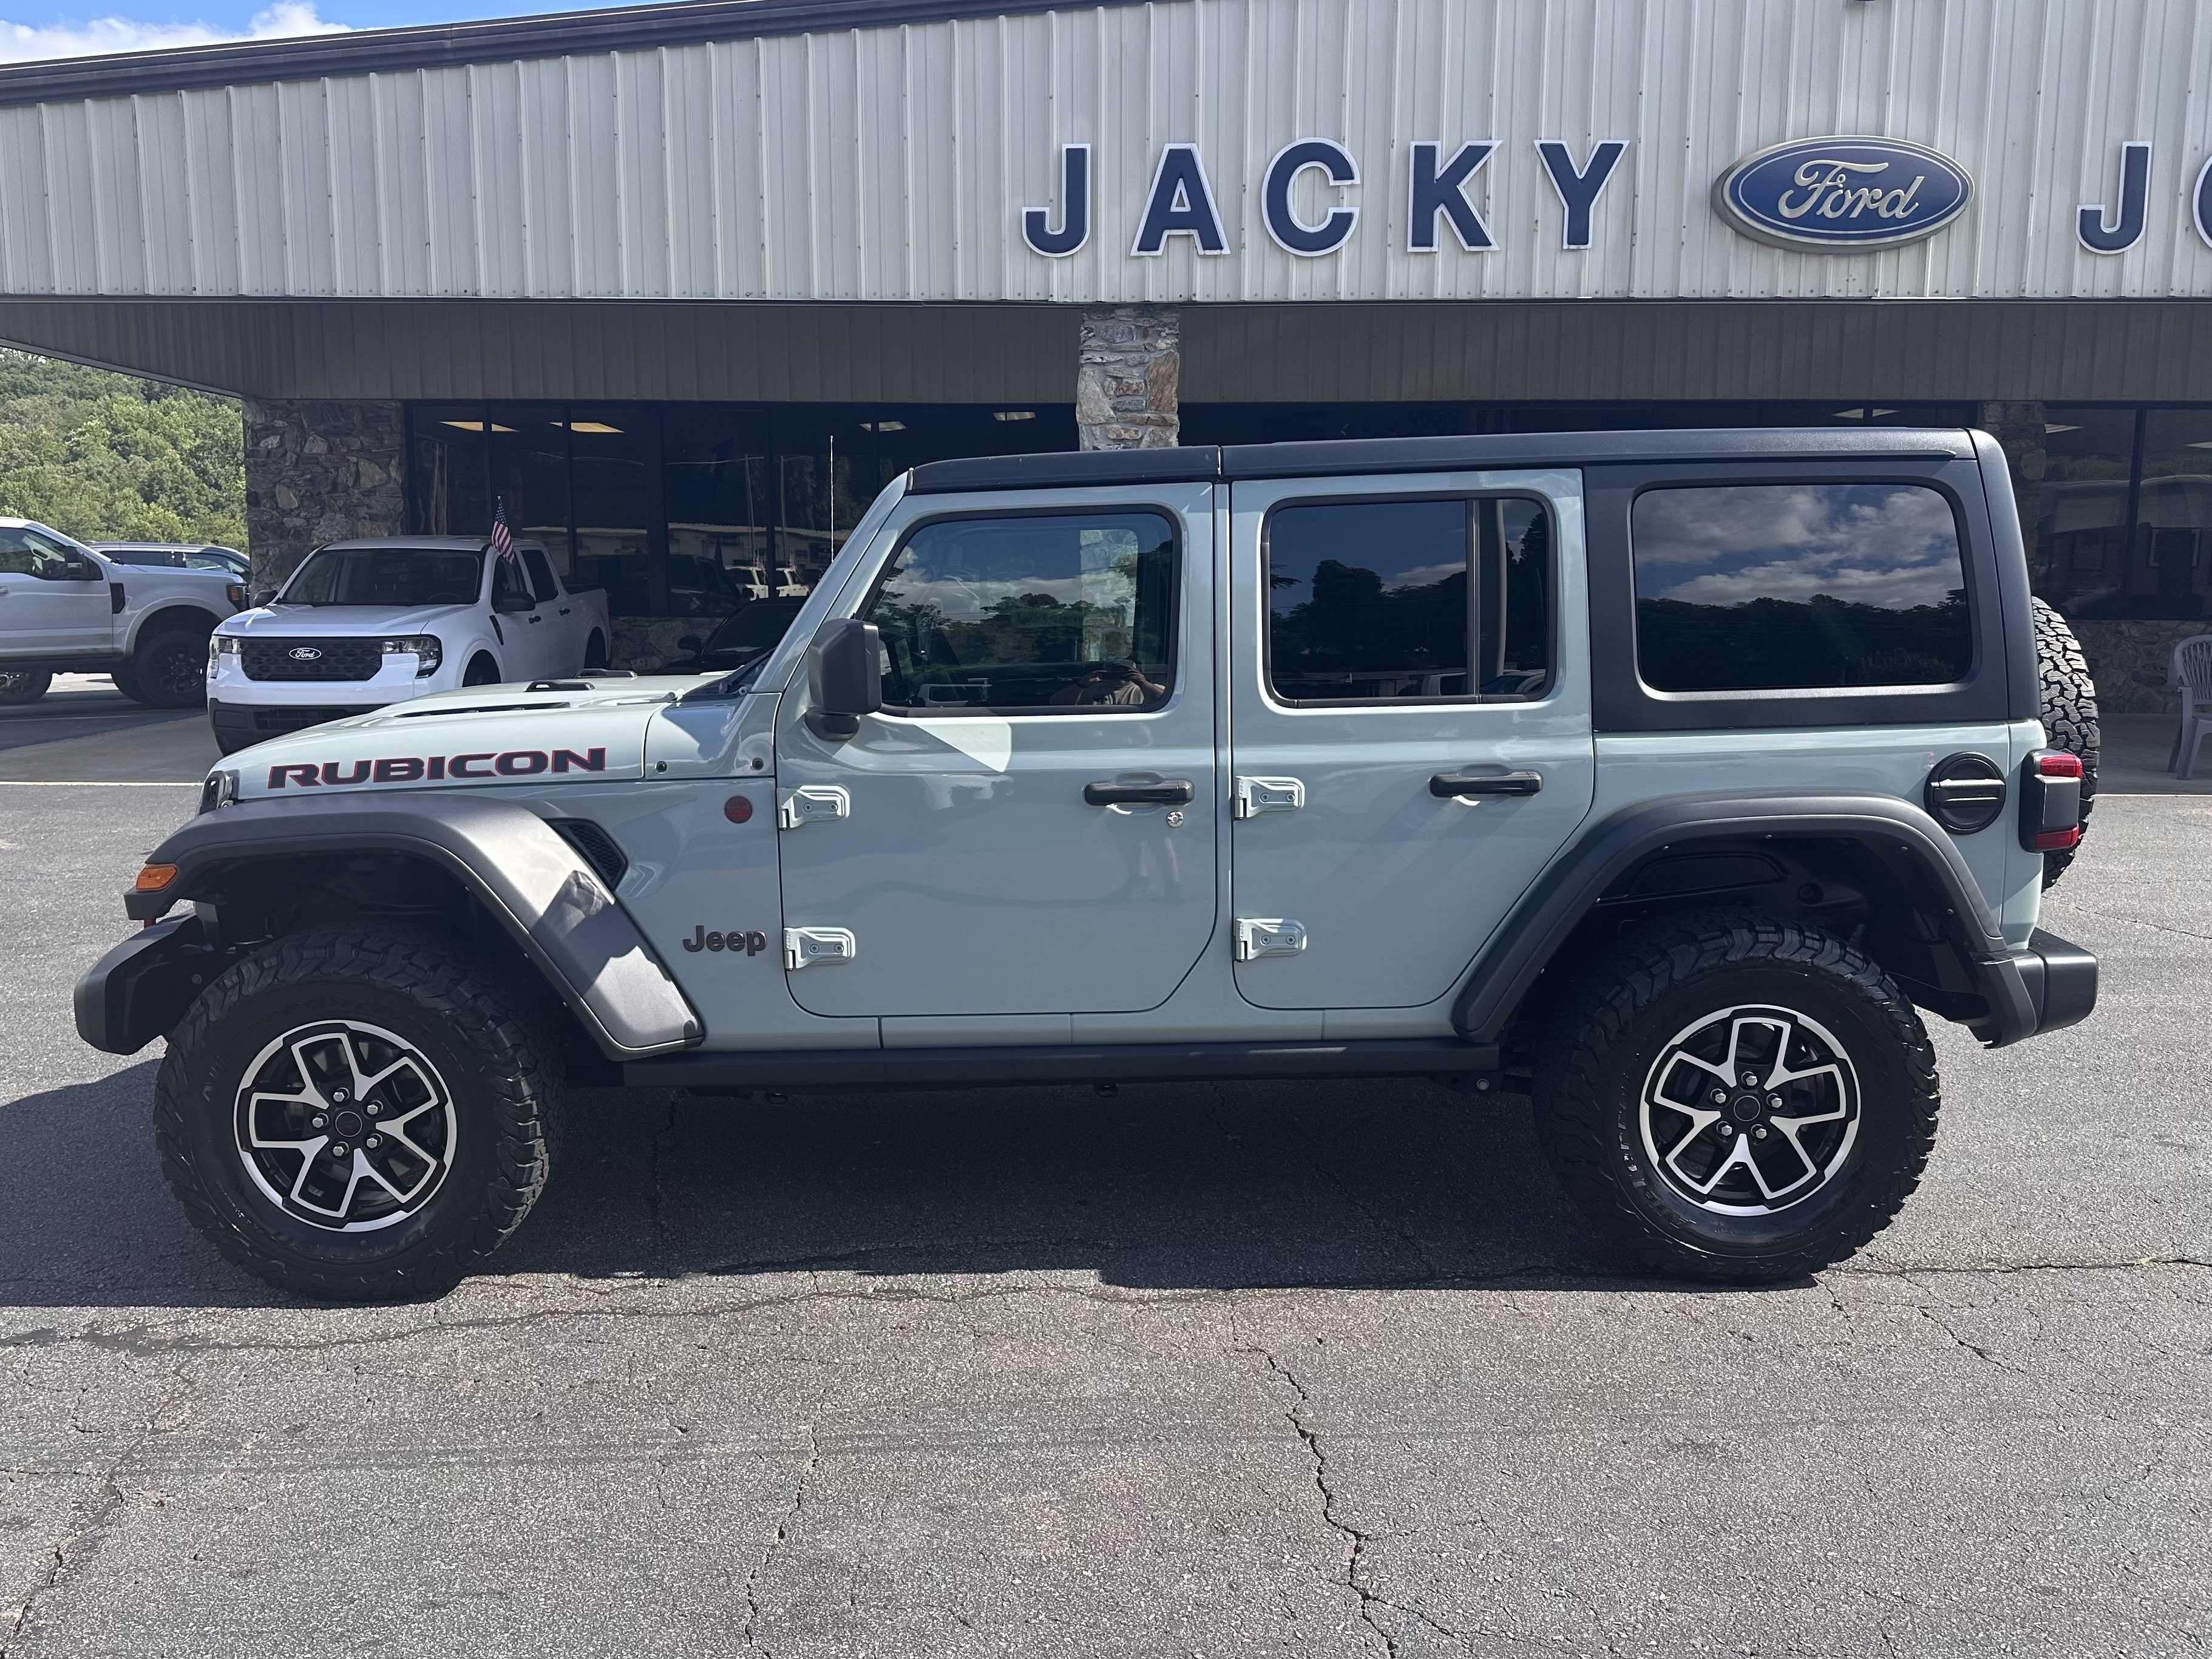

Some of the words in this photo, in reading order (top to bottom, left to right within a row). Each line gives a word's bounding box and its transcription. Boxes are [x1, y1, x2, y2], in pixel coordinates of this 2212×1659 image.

[1022, 137, 1630, 257] JACKY
[2075, 141, 2212, 255] J
[1778, 160, 1925, 219] Ford
[295, 649, 315, 658] Ford
[268, 747, 606, 789] RUBICON
[683, 925, 767, 957] Jeep
